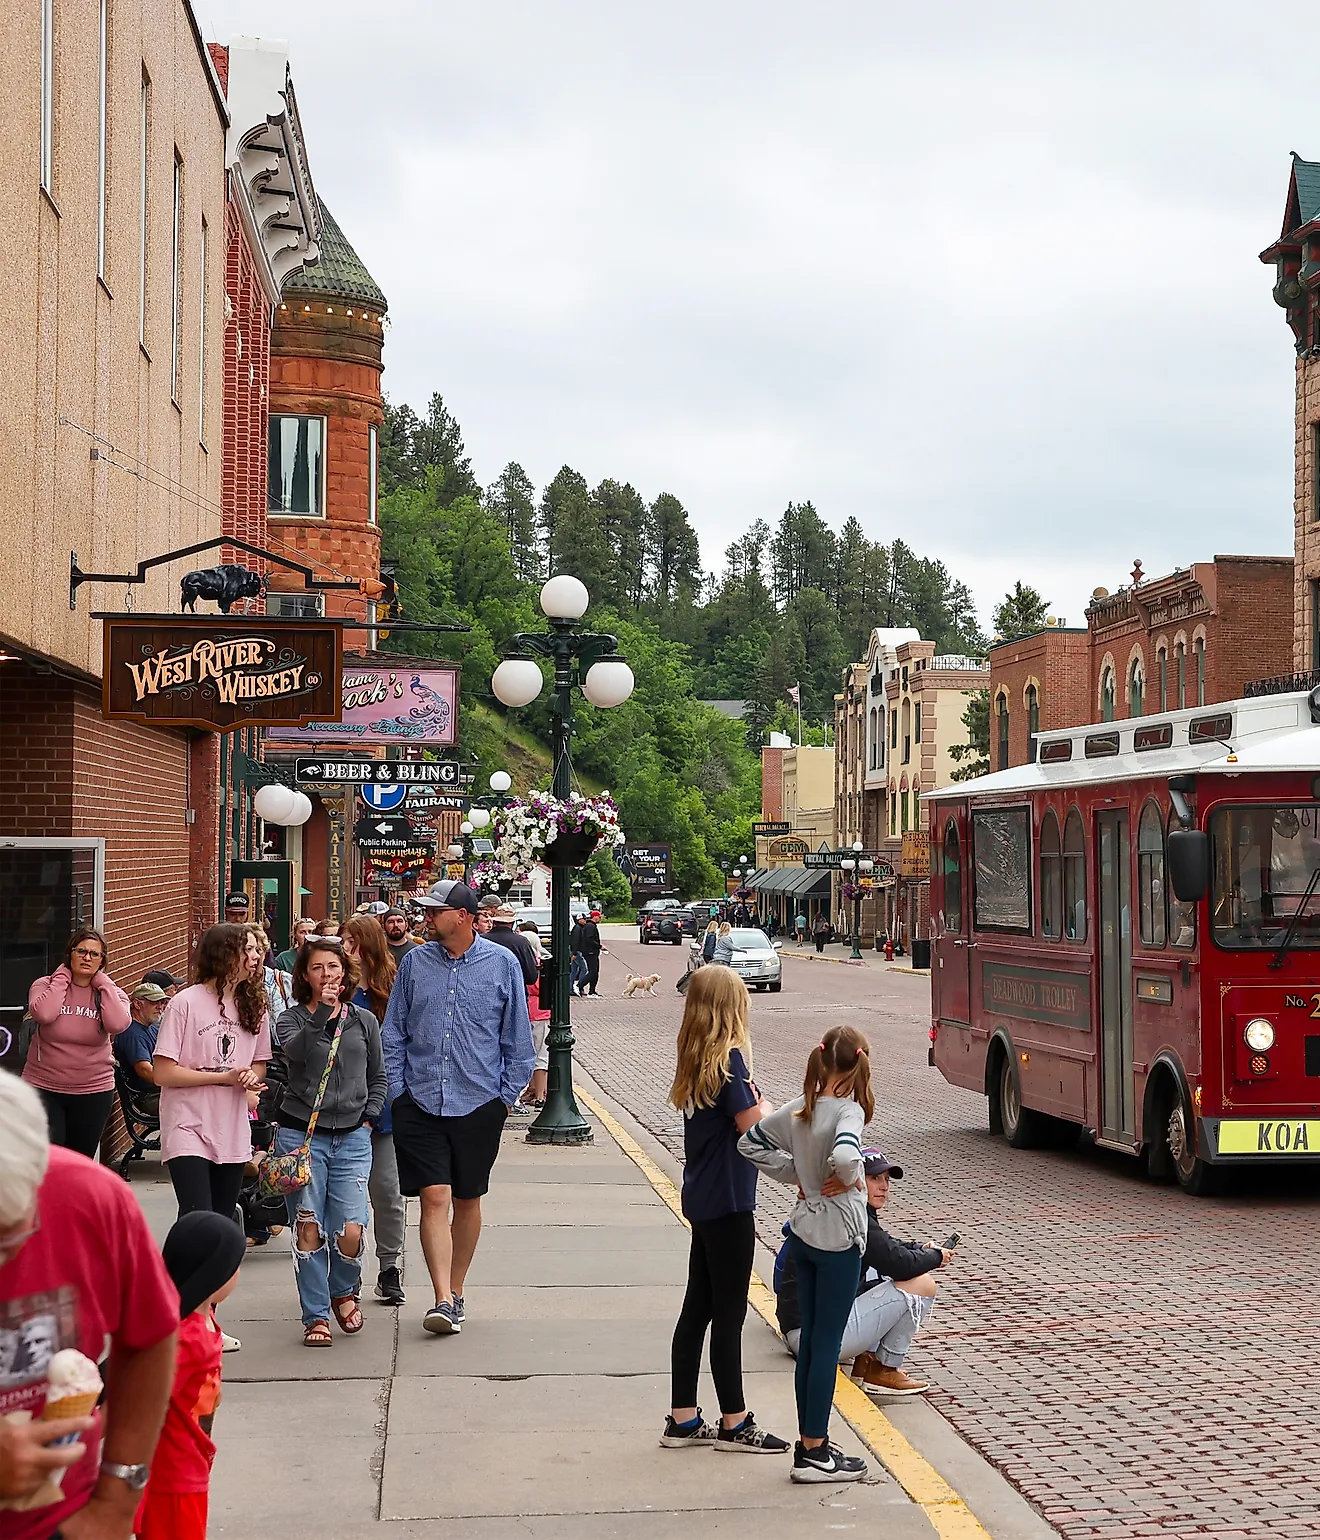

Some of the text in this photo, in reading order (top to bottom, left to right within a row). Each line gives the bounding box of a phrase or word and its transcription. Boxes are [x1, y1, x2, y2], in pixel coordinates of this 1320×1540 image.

[125, 638, 276, 702] WEST RIVER
[215, 664, 305, 706] WHISKEY
[322, 762, 455, 781] BEER & BLING
[403, 796, 464, 810] TAURANT
[359, 838, 407, 848] Public Parking
[780, 842, 804, 853] GEM
[370, 858, 425, 868] IRISH PUB
[992, 978, 1077, 1012] DEADWOOD TROLLEY
[1285, 995, 1307, 1007] No.
[59, 1005, 100, 1021] RL MAM
[1257, 1122, 1309, 1151] KOA
